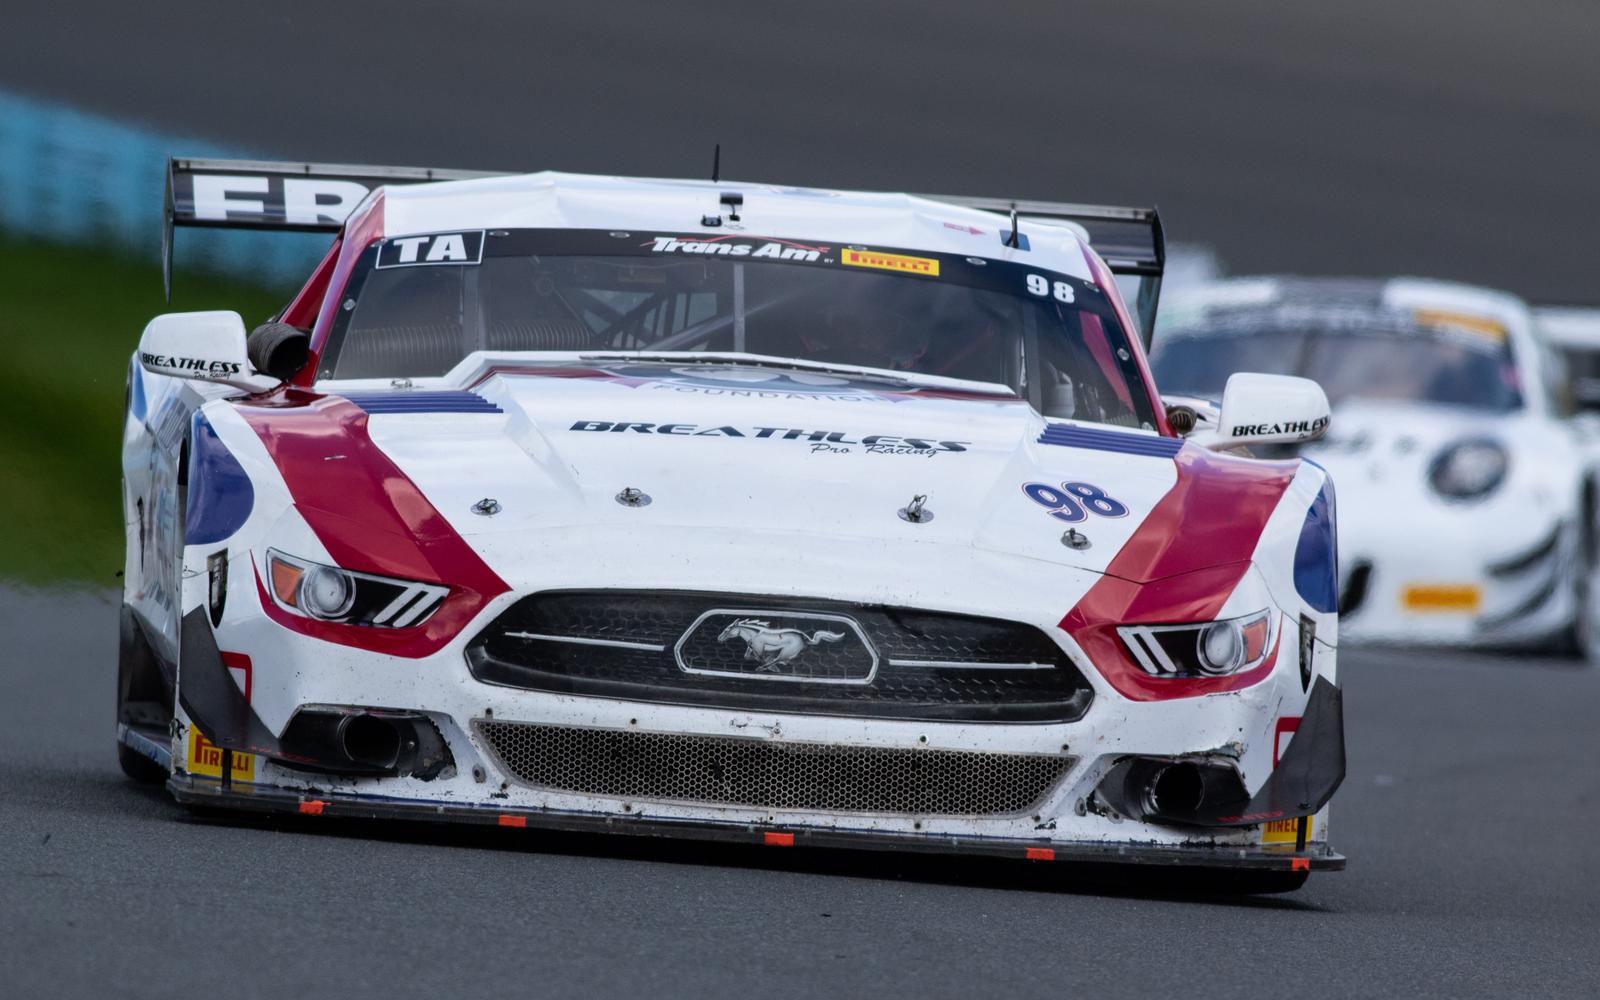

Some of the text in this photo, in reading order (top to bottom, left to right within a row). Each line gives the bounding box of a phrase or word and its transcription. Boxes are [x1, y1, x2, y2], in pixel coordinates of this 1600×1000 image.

[393, 234, 468, 263] TA
[652, 237, 752, 256] Trans
[752, 243, 821, 263] Am
[850, 252, 930, 271] PIRELLI
[1026, 273, 1075, 304] 98
[142, 352, 242, 374] BREATHLESS
[569, 420, 972, 453] BREATHLESS
[810, 443, 938, 458] Pro Racing
[1021, 481, 1130, 524] 98
